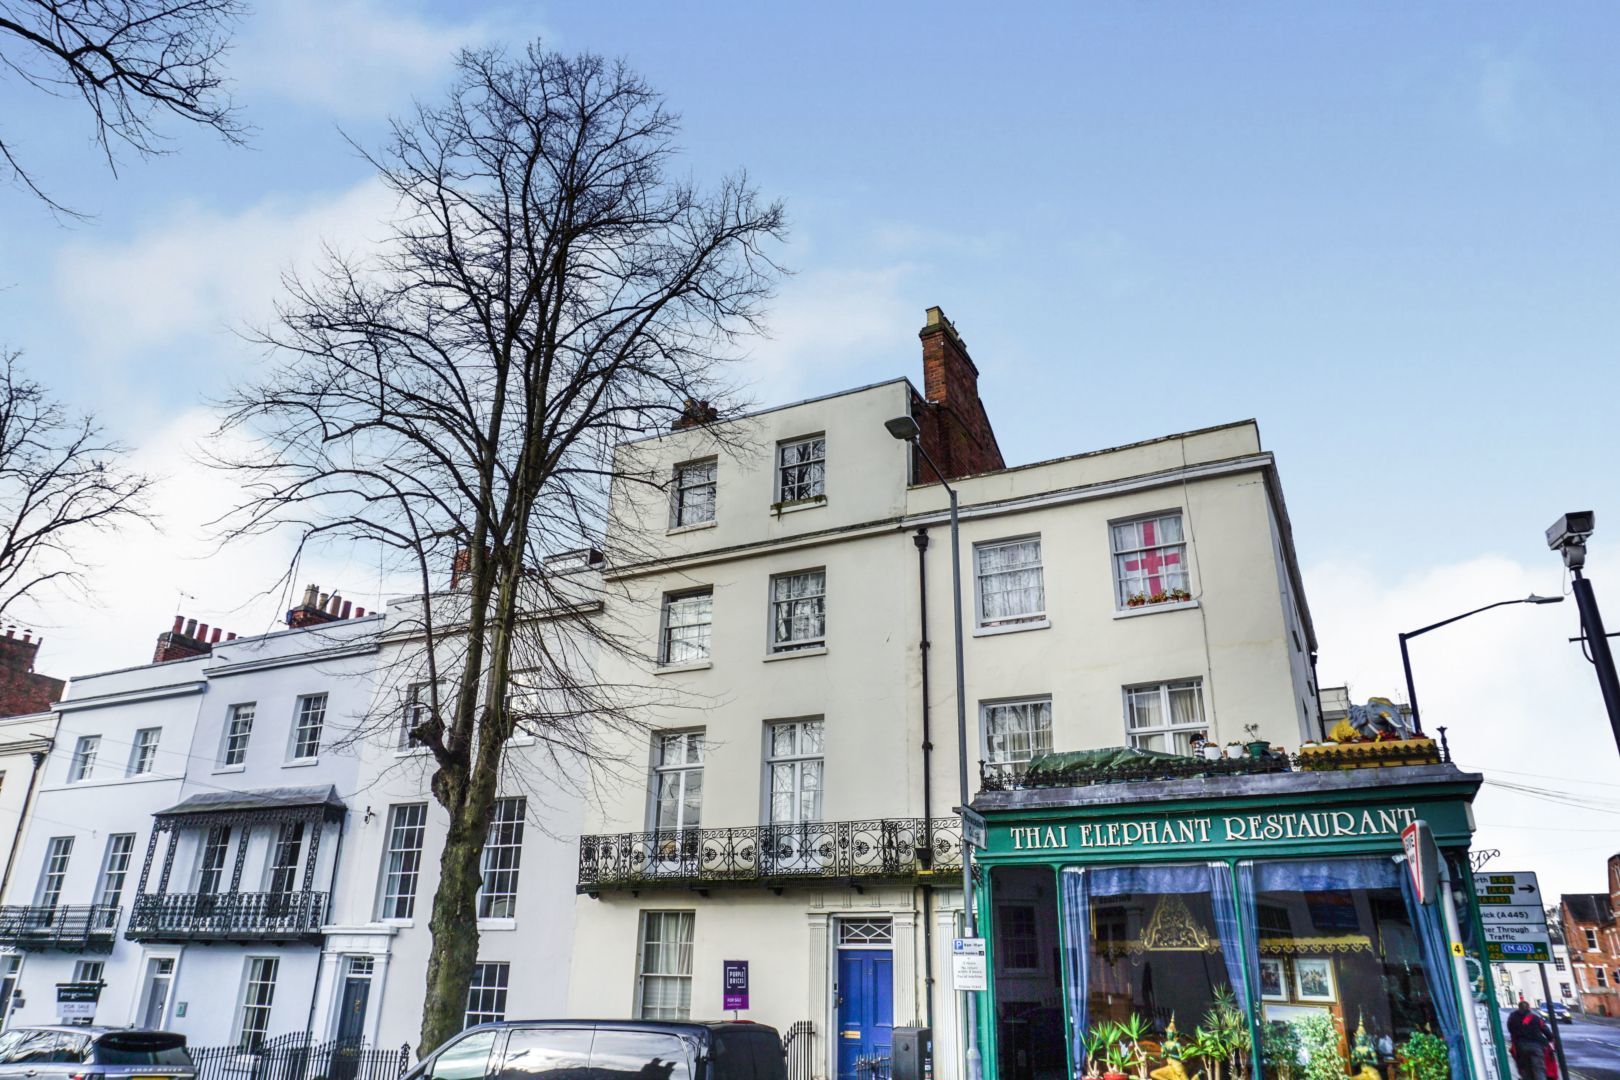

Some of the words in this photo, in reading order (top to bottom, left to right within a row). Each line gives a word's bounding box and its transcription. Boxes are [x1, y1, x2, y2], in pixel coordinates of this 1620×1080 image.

[1010, 825, 1069, 850] THAI
[1079, 817, 1212, 848] ELEPHANT
[1223, 807, 1417, 841] RESTAURANT
[1497, 926, 1530, 934] Through
[1488, 933, 1516, 941] Traffic
[1454, 944, 1461, 953] 4
